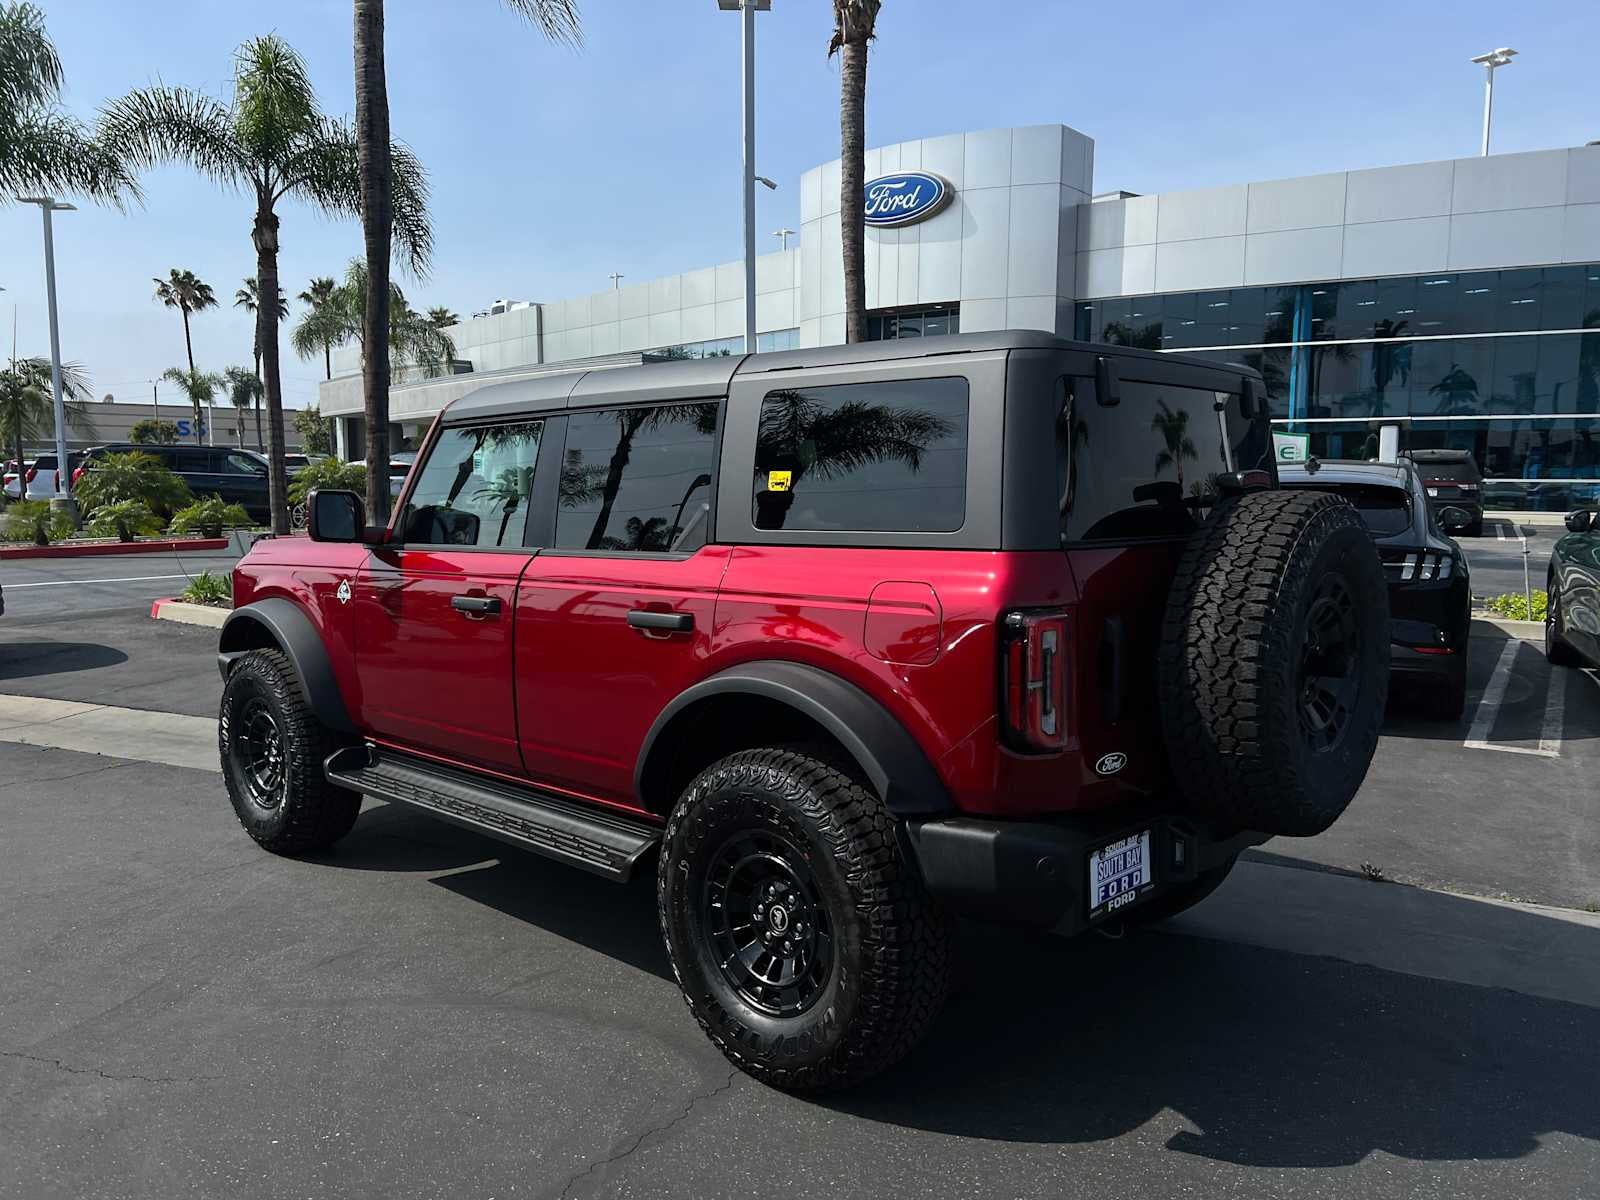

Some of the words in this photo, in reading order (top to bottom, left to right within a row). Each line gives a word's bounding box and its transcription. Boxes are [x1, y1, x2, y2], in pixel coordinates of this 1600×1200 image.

[865, 181, 922, 215] Ford
[1102, 756, 1124, 771] Ford
[1104, 839, 1126, 856] SOUTH
[1125, 834, 1140, 848] BAY
[1098, 855, 1124, 881] SOUTH
[1126, 847, 1142, 869] BAY
[1098, 870, 1141, 901] FORD
[1108, 890, 1136, 912] FORD
